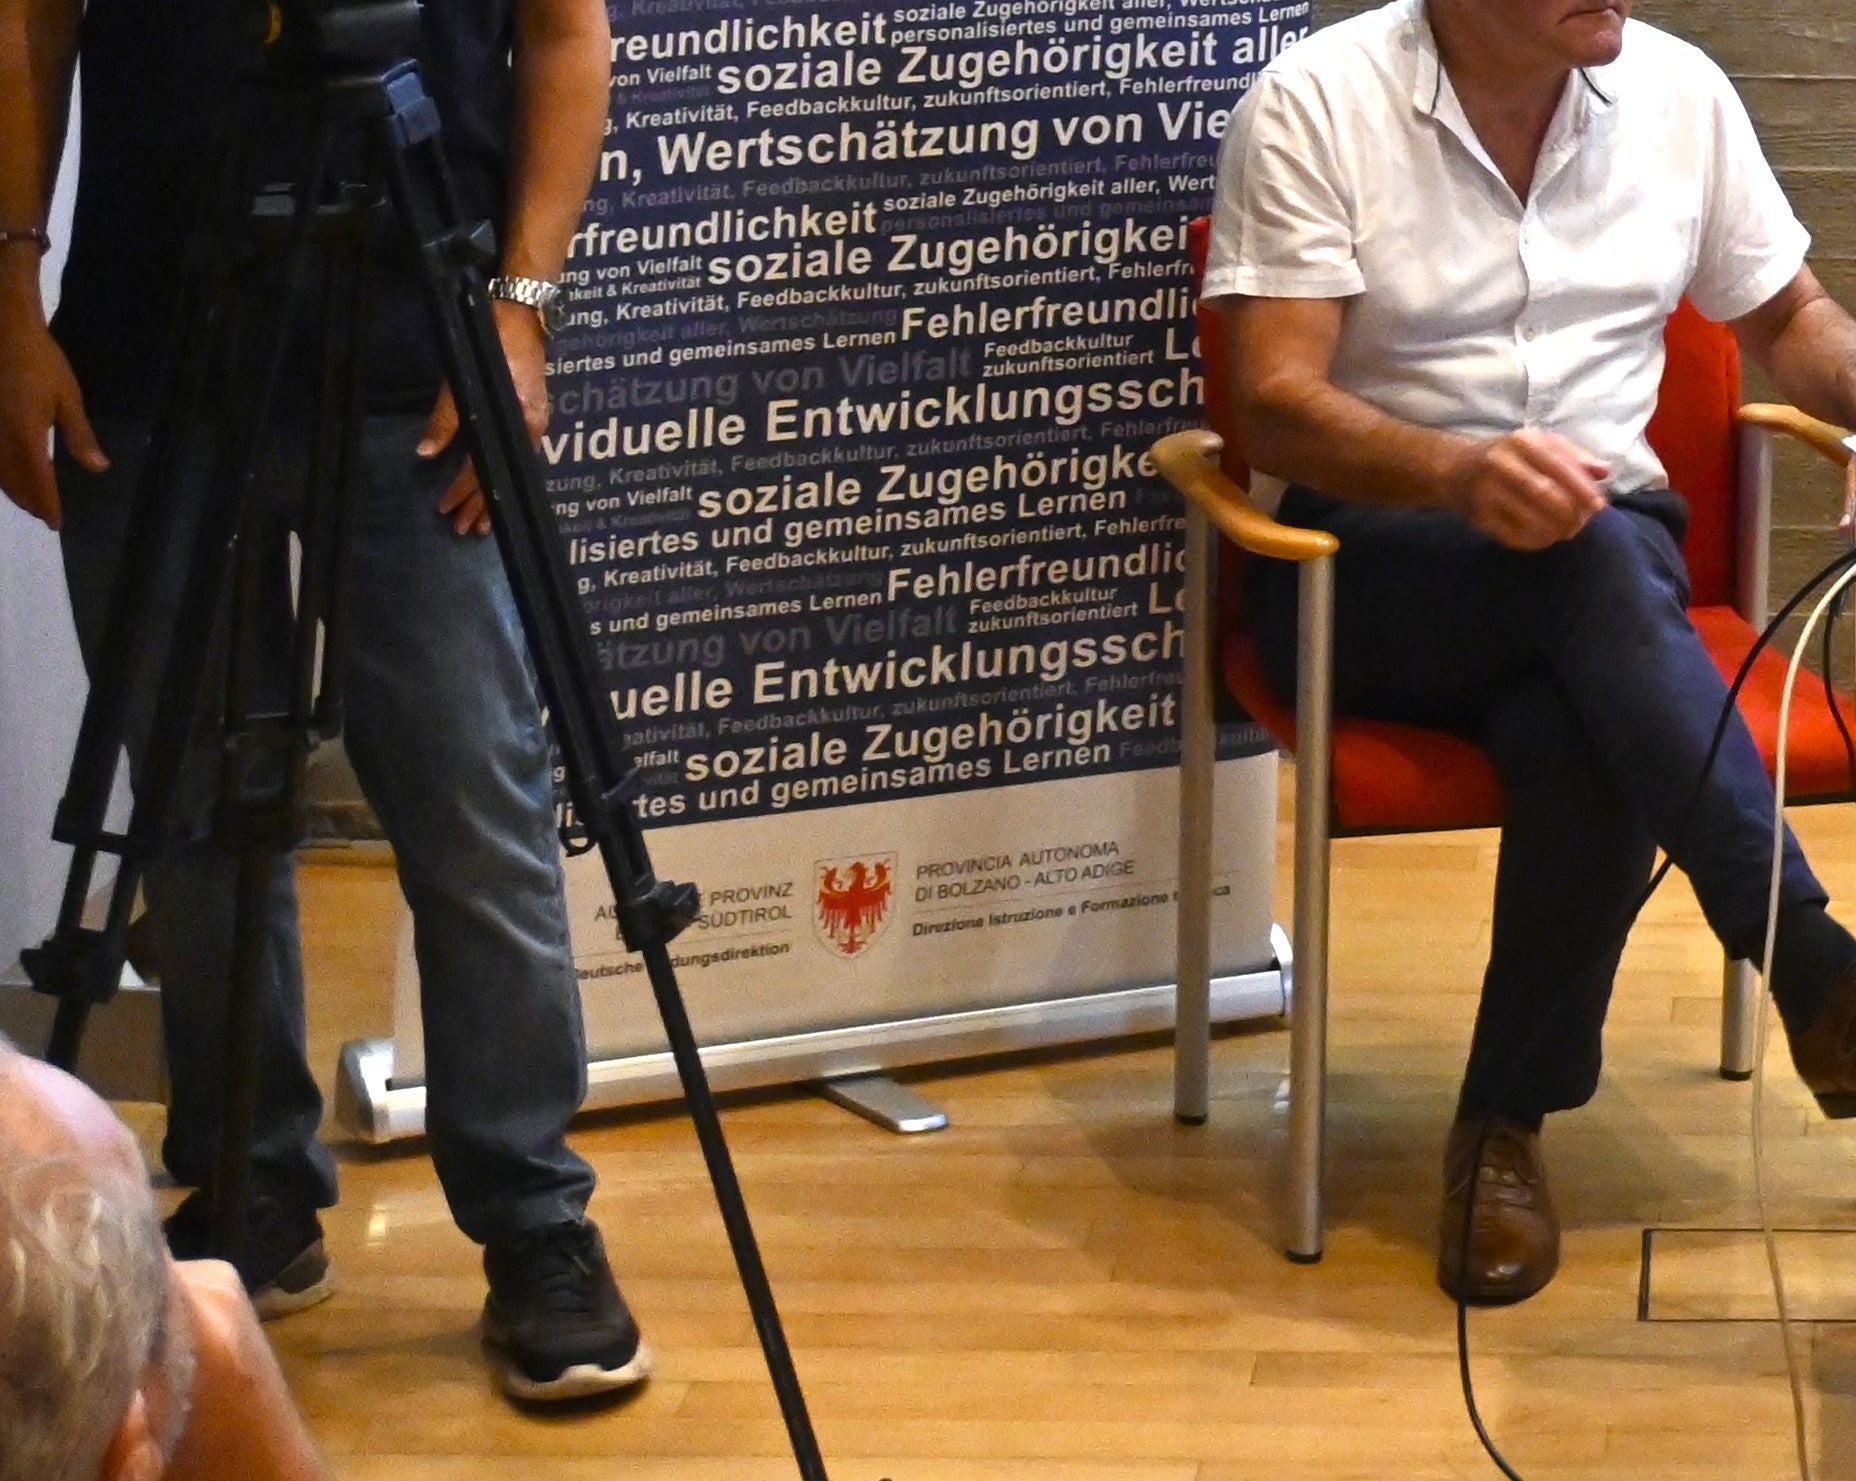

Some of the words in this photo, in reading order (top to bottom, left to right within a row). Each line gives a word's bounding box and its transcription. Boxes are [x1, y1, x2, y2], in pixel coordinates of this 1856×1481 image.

[891, 21, 1056, 47] personalisiertes
[1064, 15, 1102, 32] und
[1110, 12, 1252, 34] gemeinsames
[1258, 2, 1309, 22] Lernen
[894, 1, 965, 22] soziale
[610, 12, 887, 62] reundlichkeit
[647, 65, 712, 83] Vielfalt
[717, 50, 882, 94] soziale
[898, 31, 1217, 88] Zugehörigkeit
[626, 105, 739, 129] Kreativität,
[747, 95, 916, 119] Feedbackkultur,
[923, 83, 1112, 108] zukunftsorientiert,
[1120, 72, 1257, 95] Fehlerfreundl
[658, 118, 1040, 175] Wertschätzung
[1052, 112, 1143, 146] von
[1115, 154, 1218, 172] Fehlerfreu
[883, 191, 955, 212] soziale
[962, 179, 1104, 207] Zugehörigkeit
[1111, 179, 1161, 196] aller,
[568, 201, 877, 258] rfreundlichkeit
[597, 265, 630, 279] von
[637, 255, 702, 275] Vielfalt
[708, 240, 872, 285] soziale
[888, 217, 1191, 276] Zugehörigkei
[616, 298, 729, 321] Kreativität,
[737, 284, 906, 308] Feedbackkultur,
[913, 267, 1101, 295] zukunftsorientiert,
[622, 276, 701, 295] Kreativität
[902, 287, 1199, 340] Fehlerfreundli
[623, 348, 662, 367] und
[669, 337, 815, 366] gemeinsames
[823, 331, 895, 350] Lernen
[983, 351, 1154, 378] zukunftsorientiert
[984, 333, 1133, 358] Feedbackkultur
[548, 374, 738, 415] chätzung
[542, 407, 746, 465] viduelle
[767, 368, 1204, 441] Entwicklungssch
[587, 497, 620, 511] von
[627, 487, 692, 506] Vielfalt
[698, 472, 860, 518] soziale
[877, 443, 1158, 504] Zugehörigke
[569, 529, 699, 565] lisiertes
[712, 517, 772, 548] und
[785, 500, 1006, 548] gemeinsames
[1018, 489, 1127, 518] Lernen
[604, 561, 718, 587] Kreativität,
[726, 544, 893, 573] Feedbackkultur,
[901, 525, 1087, 557] zukunftsorientiert,
[888, 542, 1185, 601] Fehlerfreundlic
[609, 613, 648, 632] und
[656, 599, 801, 630] gemeinsames
[809, 592, 882, 611] Lernen
[968, 601, 1138, 633] zukunftsorientiert
[970, 586, 1118, 614] Feedbackkultur
[753, 620, 1184, 704] Entwicklungssch
[623, 722, 709, 749] ativität,
[684, 732, 847, 781] soziale
[862, 692, 1176, 763] Zugehörigkeit
[634, 749, 679, 768] elfalt
[699, 779, 759, 811] und
[771, 756, 991, 808] gemeinsames
[1003, 742, 1110, 774] Lernen
[917, 854, 1012, 880] PROVINCIA
[1019, 841, 1120, 868] AUTONOMA
[710, 882, 794, 905] PROVINZ
[915, 887, 933, 902] DI
[938, 875, 1020, 899] BOLZANO
[1034, 869, 1077, 887] ALTO
[1081, 860, 1135, 879] ADIGE
[698, 905, 792, 930] SÜDTIROL
[672, 941, 790, 970] dungsdirektion
